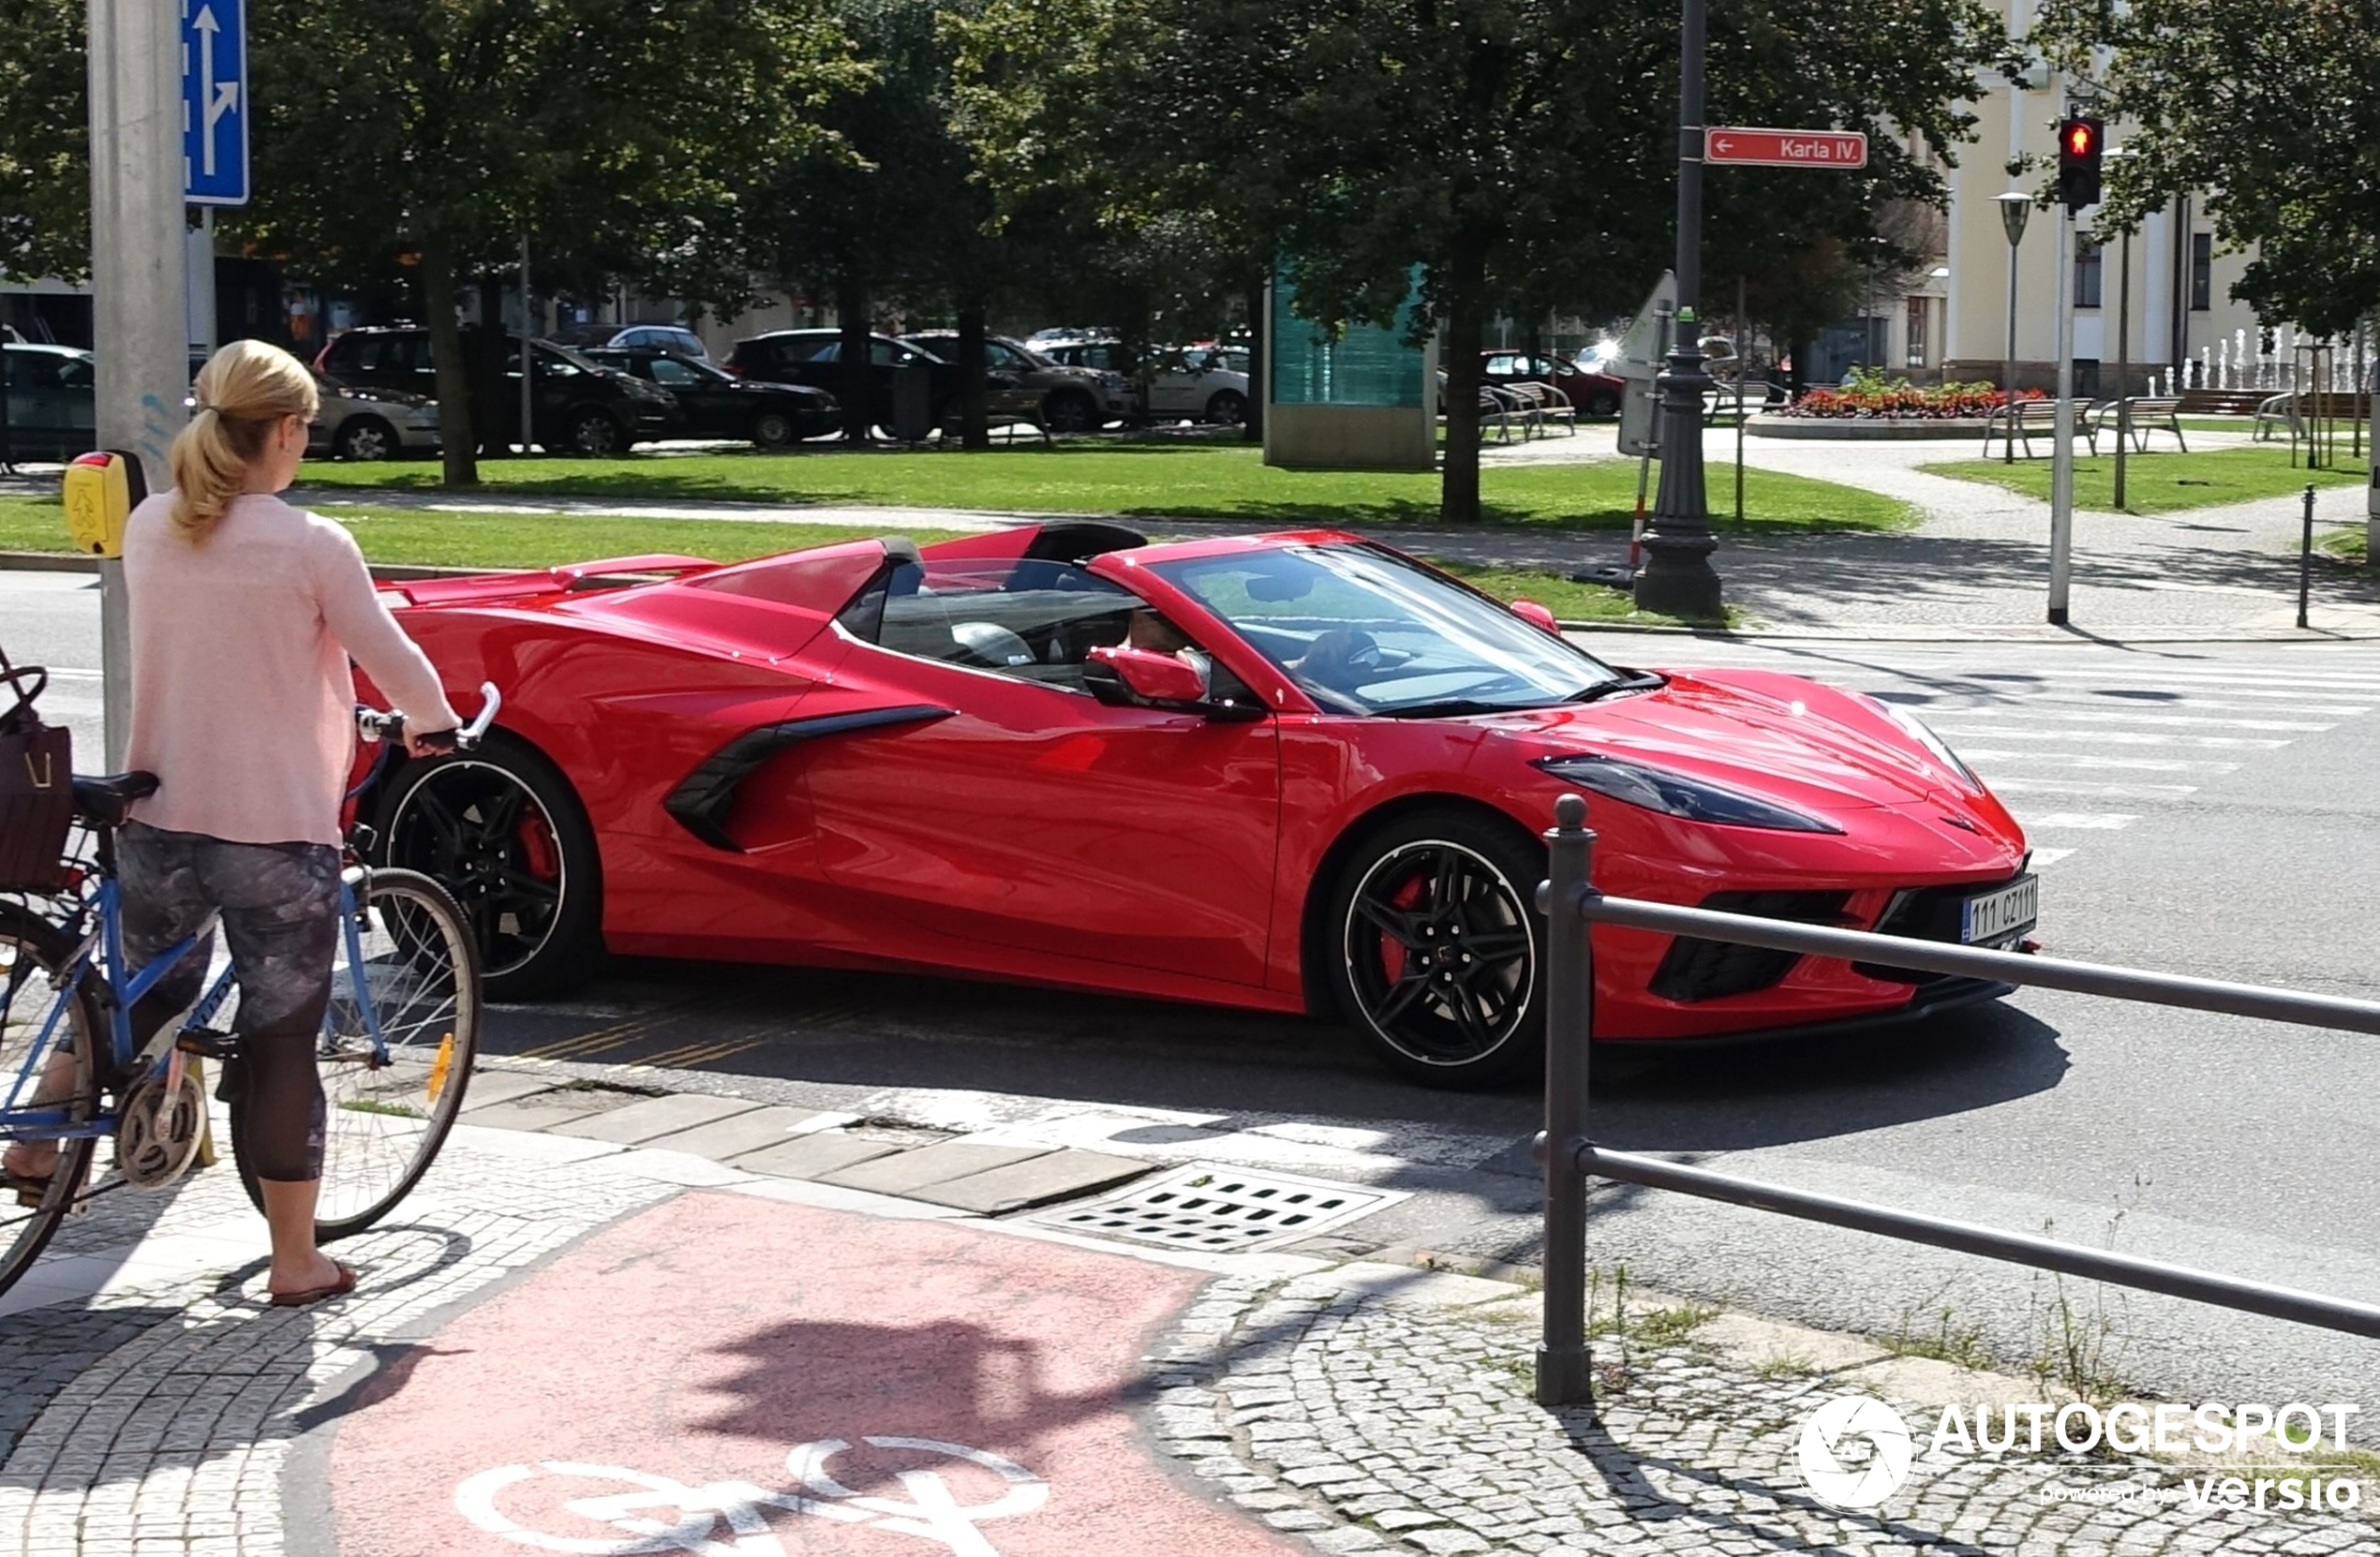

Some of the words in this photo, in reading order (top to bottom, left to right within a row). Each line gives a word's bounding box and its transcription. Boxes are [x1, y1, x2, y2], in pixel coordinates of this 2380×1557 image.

[1780, 139, 1830, 158] Karla
[1837, 141, 1857, 159] IV.
[1973, 898, 1996, 936] 111
[2003, 883, 2034, 925] CZ111
